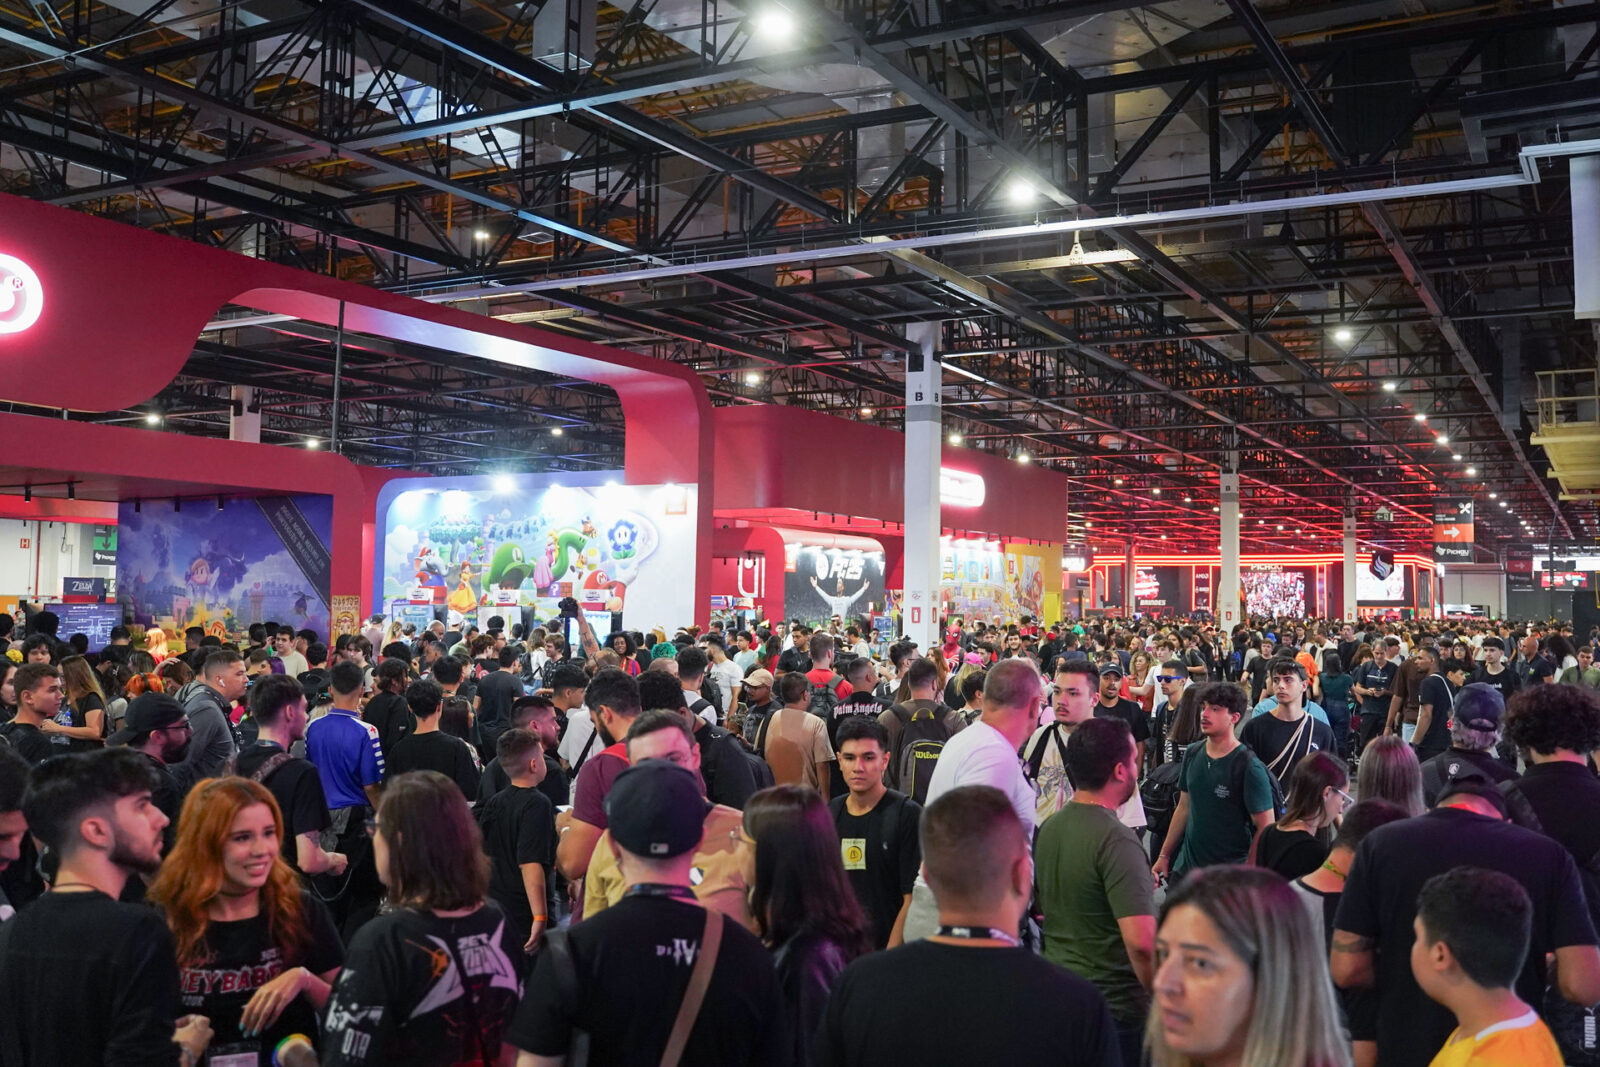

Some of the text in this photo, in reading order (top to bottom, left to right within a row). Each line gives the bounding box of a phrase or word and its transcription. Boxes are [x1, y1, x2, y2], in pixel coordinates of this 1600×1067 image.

[915, 392, 924, 402] B
[934, 392, 939, 402] B
[853, 702, 883, 716] Angels
